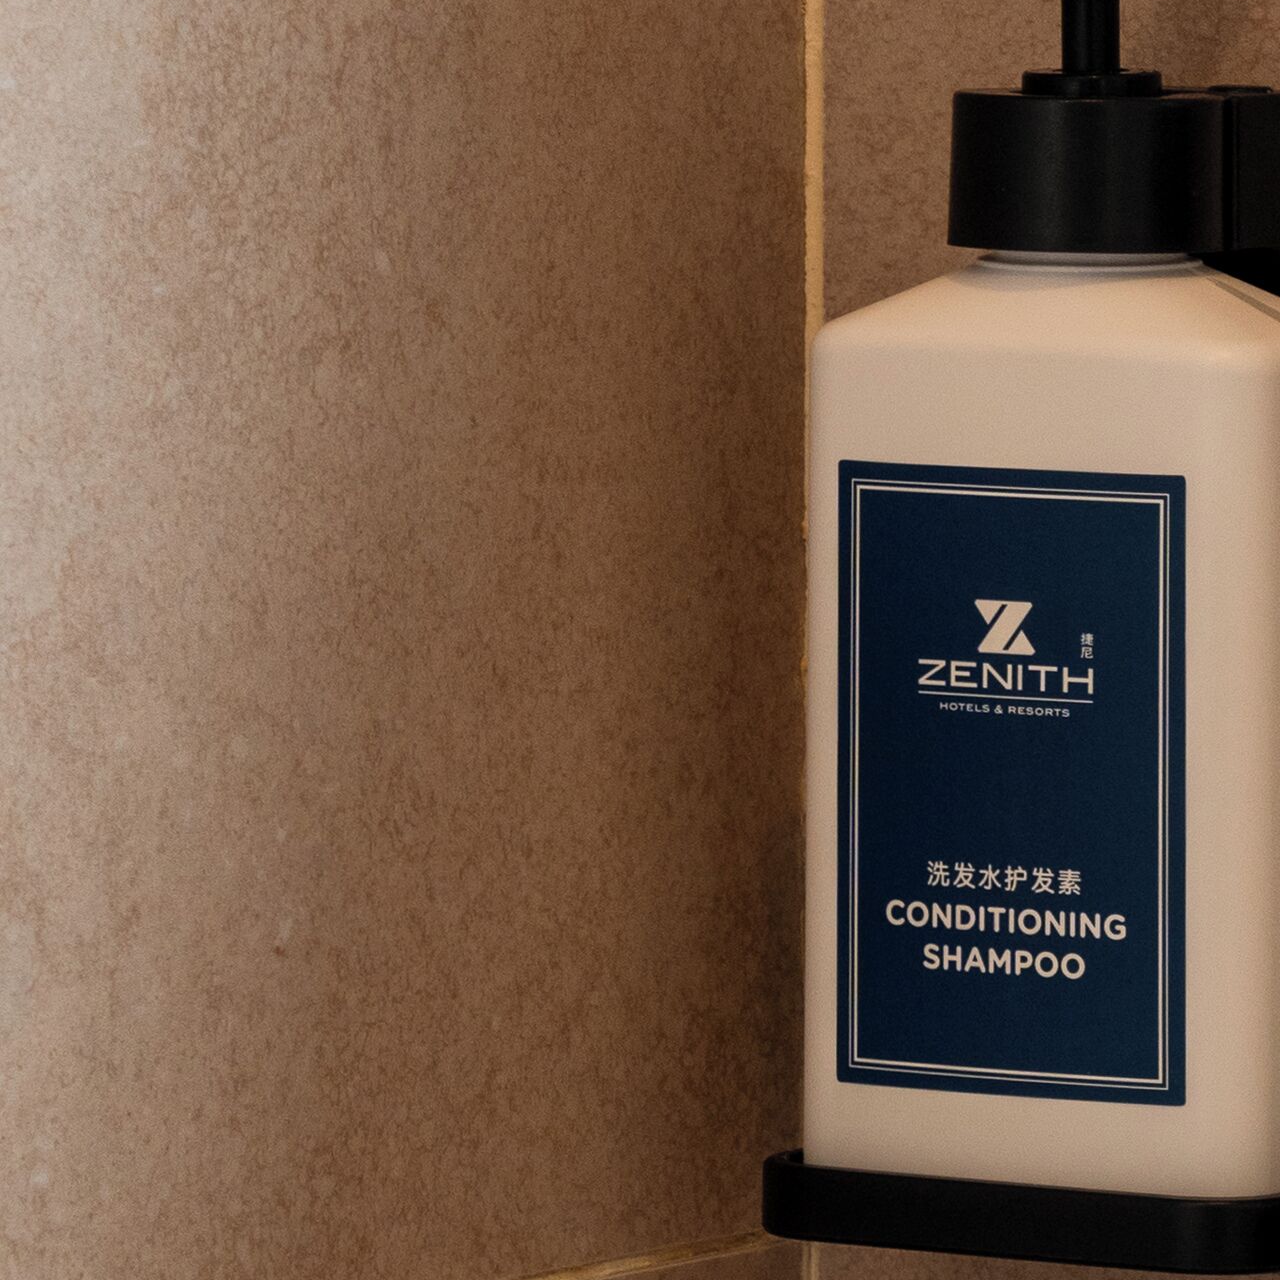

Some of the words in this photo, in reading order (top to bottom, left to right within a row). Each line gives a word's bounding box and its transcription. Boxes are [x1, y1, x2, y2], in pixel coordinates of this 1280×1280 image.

[917, 658, 1094, 695] ZENITH
[939, 702, 991, 714] HOTELS
[993, 704, 1003, 715] &
[1007, 705, 1070, 718] RESORTS
[927, 860, 1082, 896] 洗发水护发素
[885, 899, 1127, 941] CONDITIONING
[922, 943, 1086, 980] SHAMPOO
